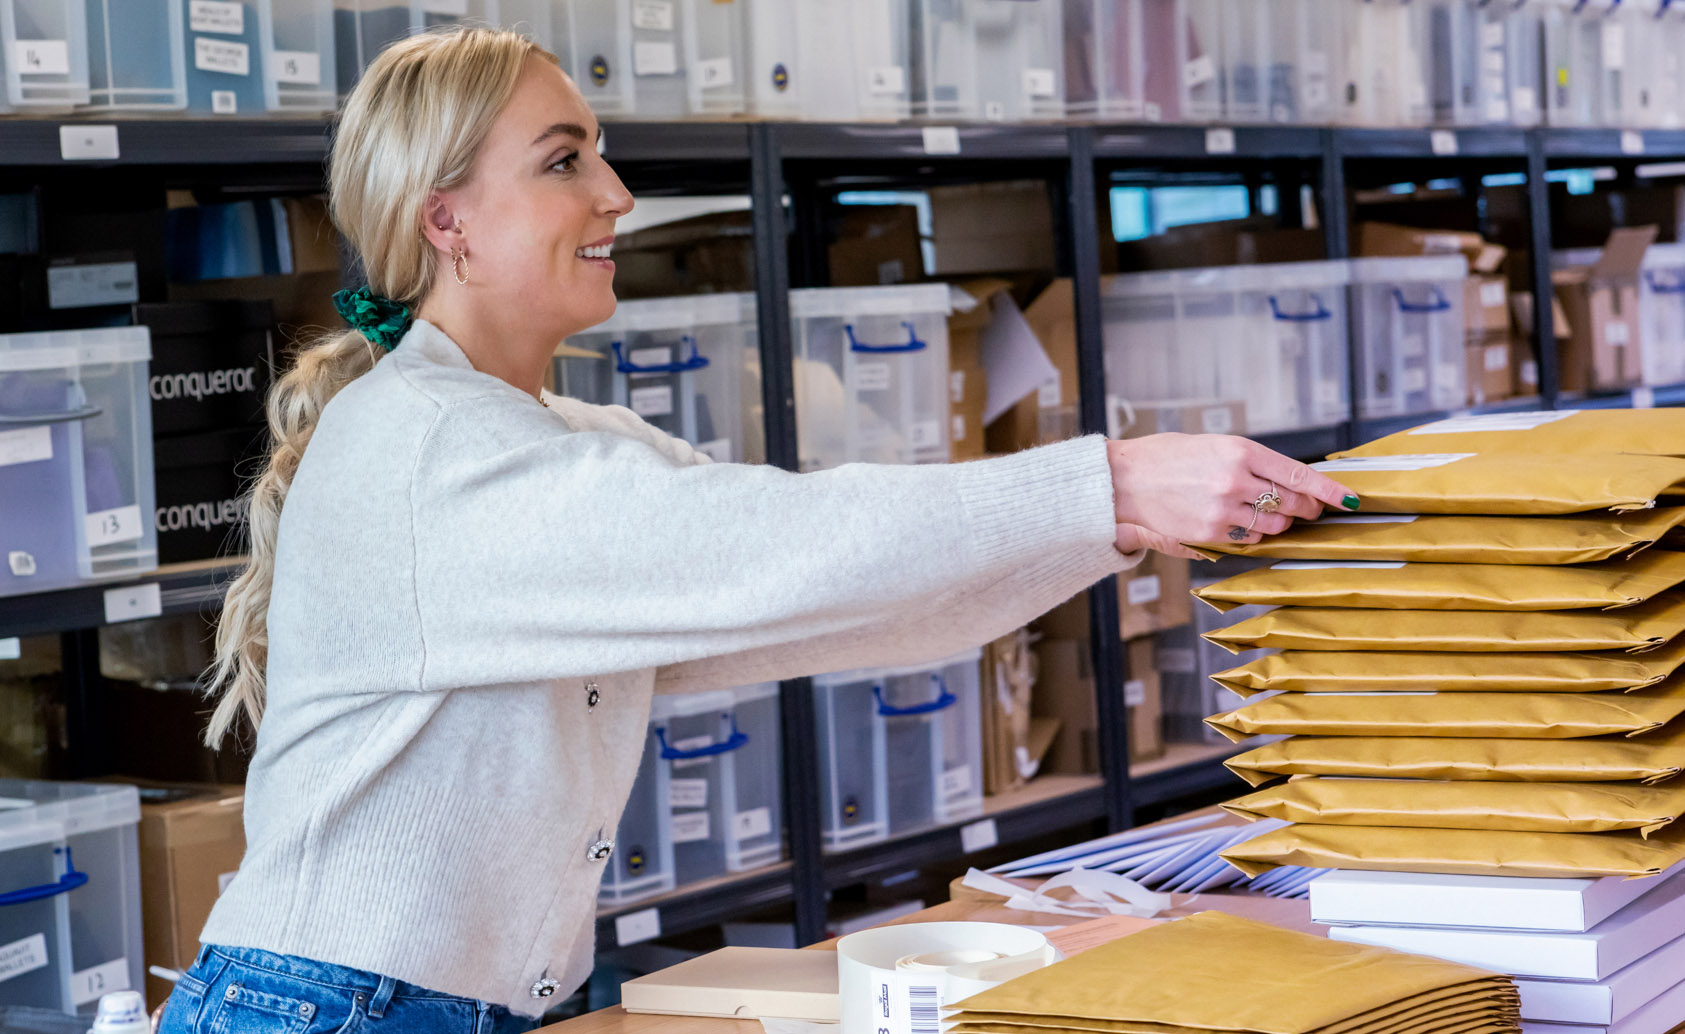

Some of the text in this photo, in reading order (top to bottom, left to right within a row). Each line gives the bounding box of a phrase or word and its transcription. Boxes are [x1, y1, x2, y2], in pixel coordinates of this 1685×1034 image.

[150, 367, 256, 402] conqueror
[102, 514, 121, 536] 13
[87, 972, 105, 993] 12
